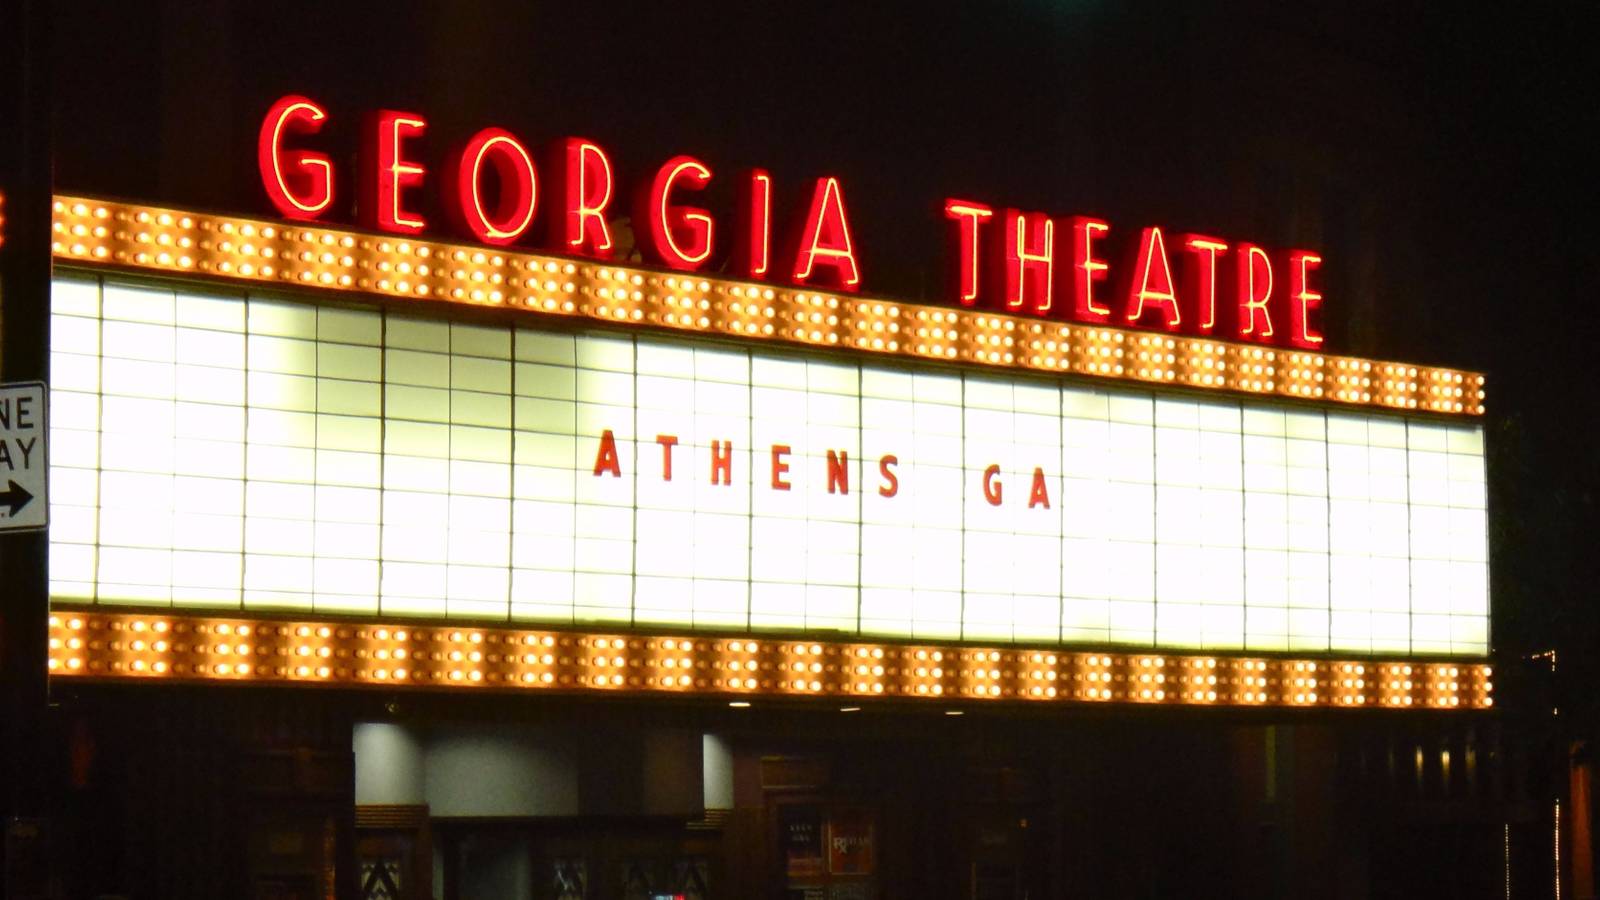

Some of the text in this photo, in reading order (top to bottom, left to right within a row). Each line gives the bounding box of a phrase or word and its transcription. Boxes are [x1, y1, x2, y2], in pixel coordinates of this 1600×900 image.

[257, 94, 1324, 347] GEORGIA THEATRE
[593, 430, 1050, 508] ATHENS GA
